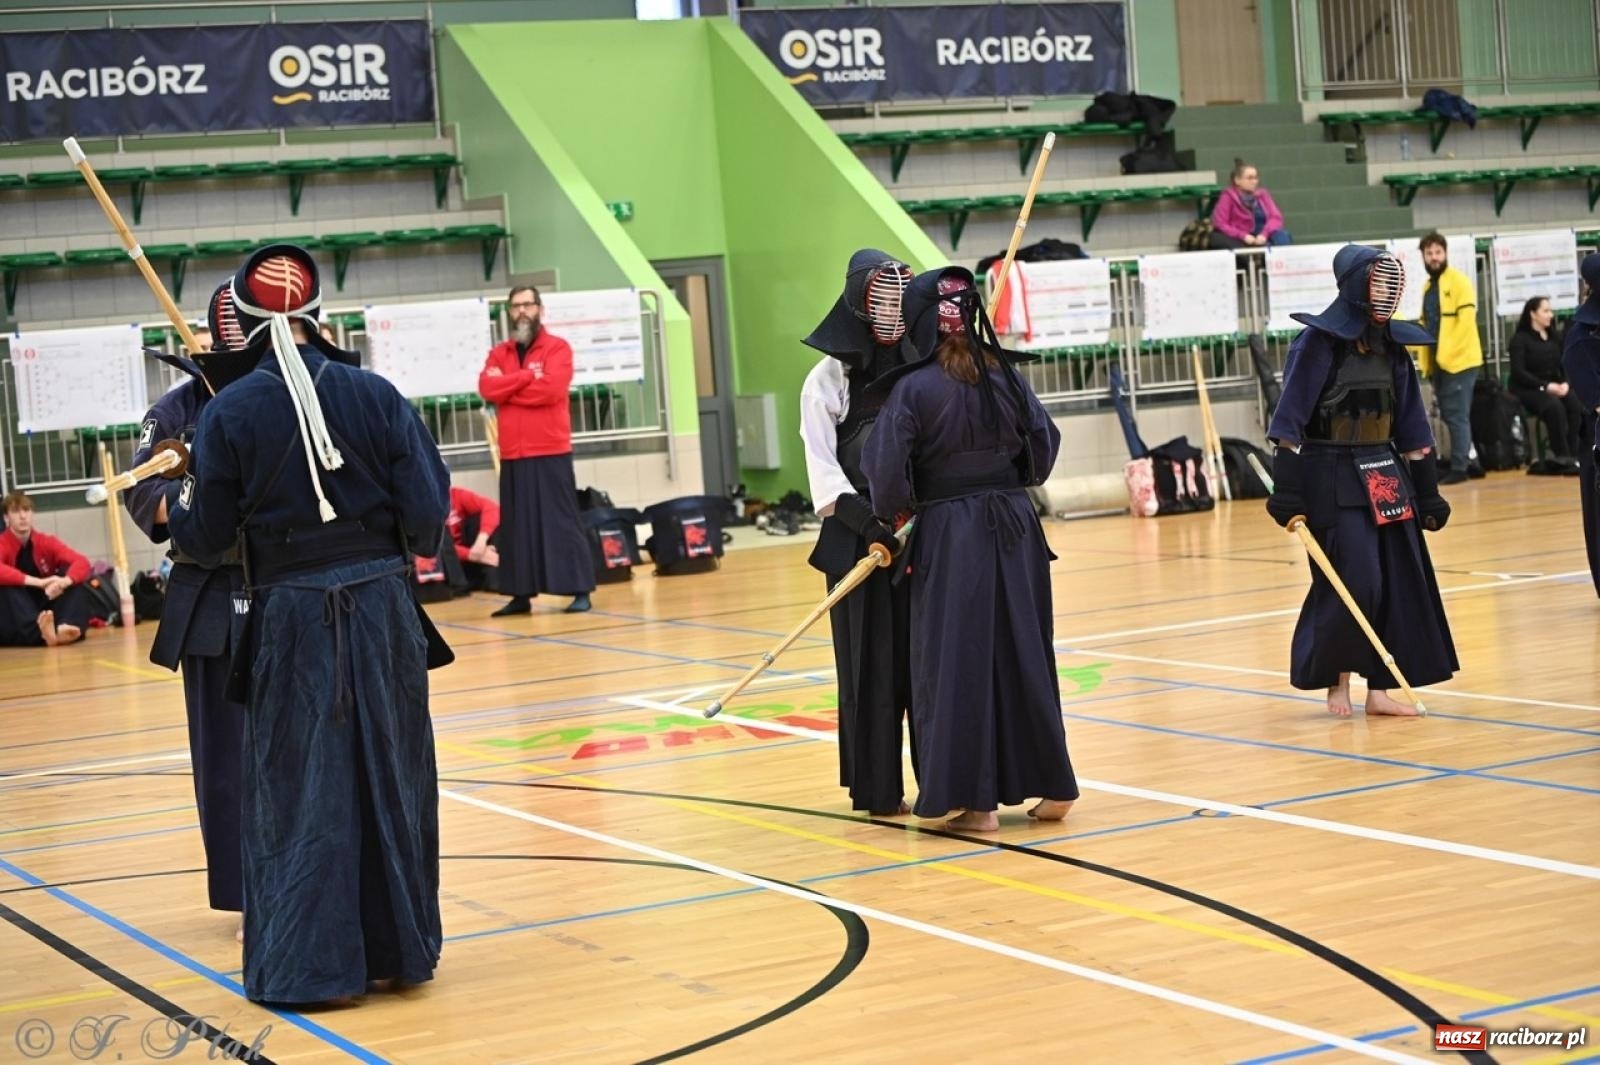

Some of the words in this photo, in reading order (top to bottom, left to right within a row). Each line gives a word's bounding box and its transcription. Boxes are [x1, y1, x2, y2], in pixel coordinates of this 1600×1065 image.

[269, 43, 389, 88] OSiR
[779, 27, 885, 69] OSiR
[936, 28, 1094, 66] RACIBÓRZ
[6, 55, 208, 101] RACIBÓRZ
[318, 85, 391, 103] RACIBÓRZ
[823, 67, 886, 84] RACIBÓRZ
